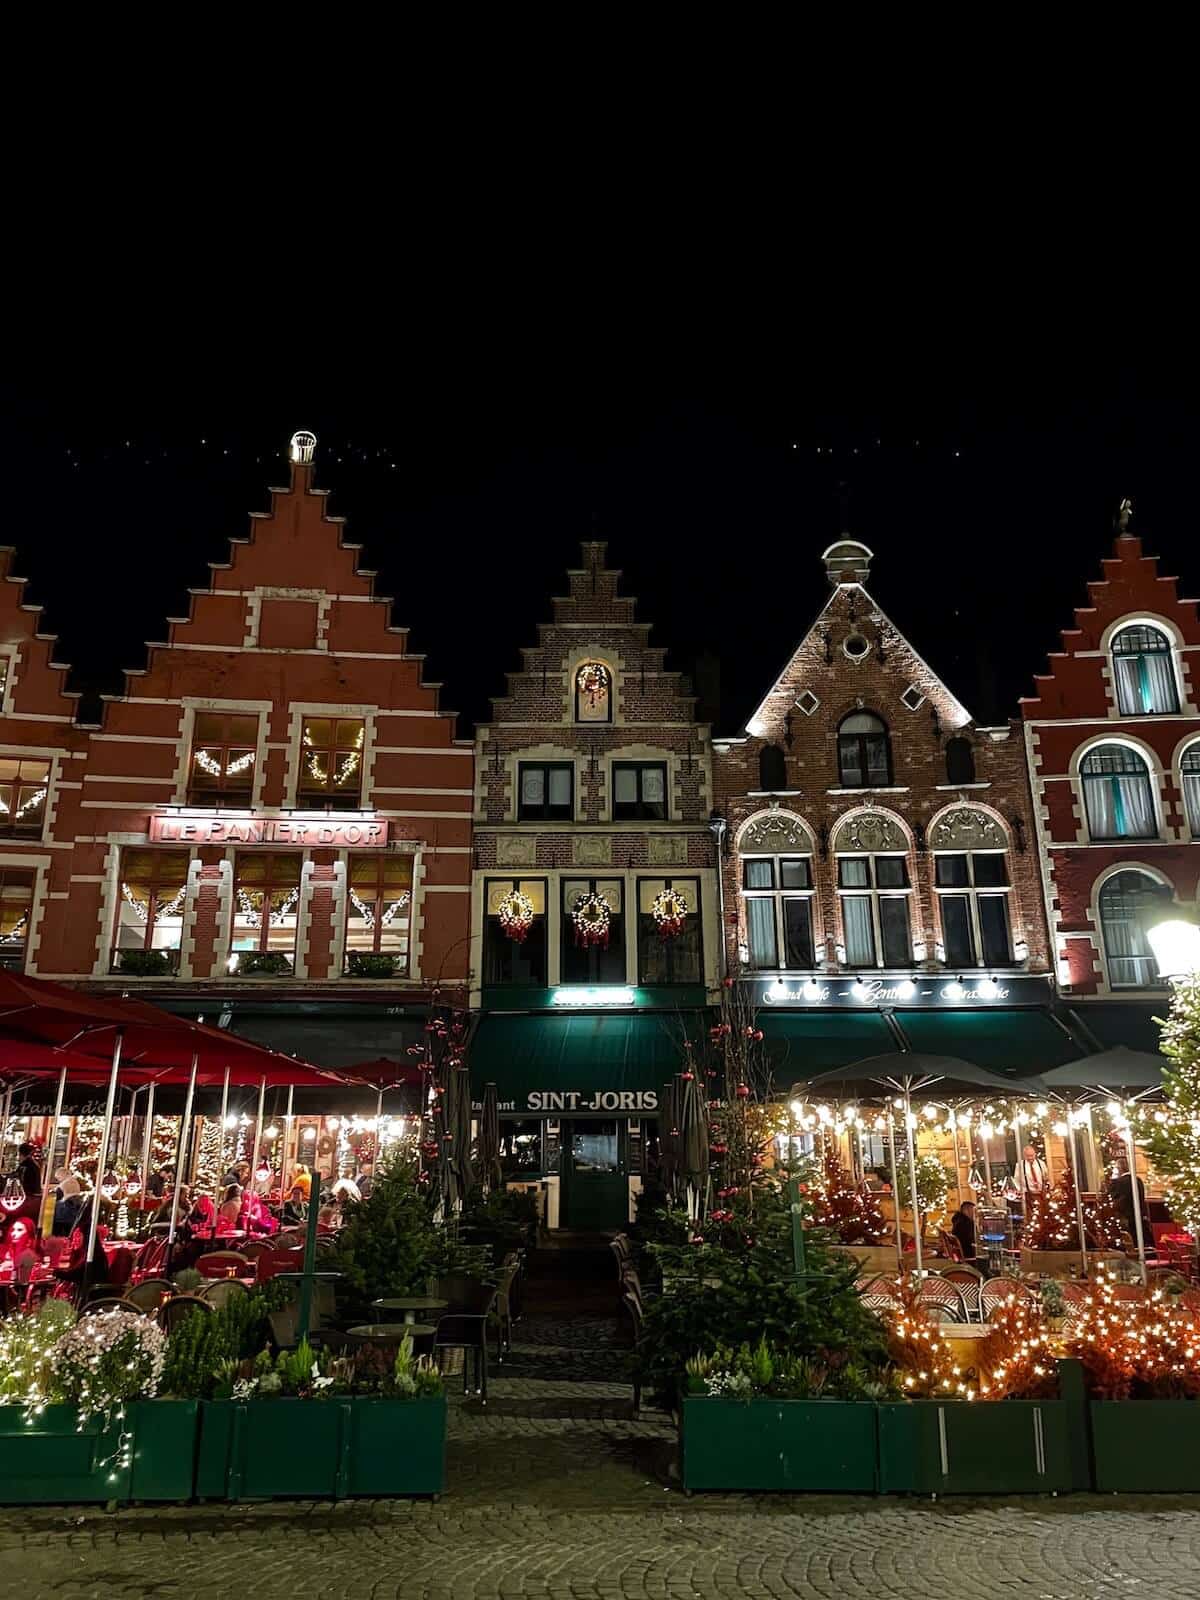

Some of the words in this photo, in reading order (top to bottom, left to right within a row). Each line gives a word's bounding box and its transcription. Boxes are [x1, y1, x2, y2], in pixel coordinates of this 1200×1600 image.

[160, 823, 197, 840] LE
[205, 823, 308, 843] PANIER
[318, 825, 383, 845] D'OR
[19, 1101, 79, 1113] Paner
[527, 1091, 658, 1110] SINT-JORIS
